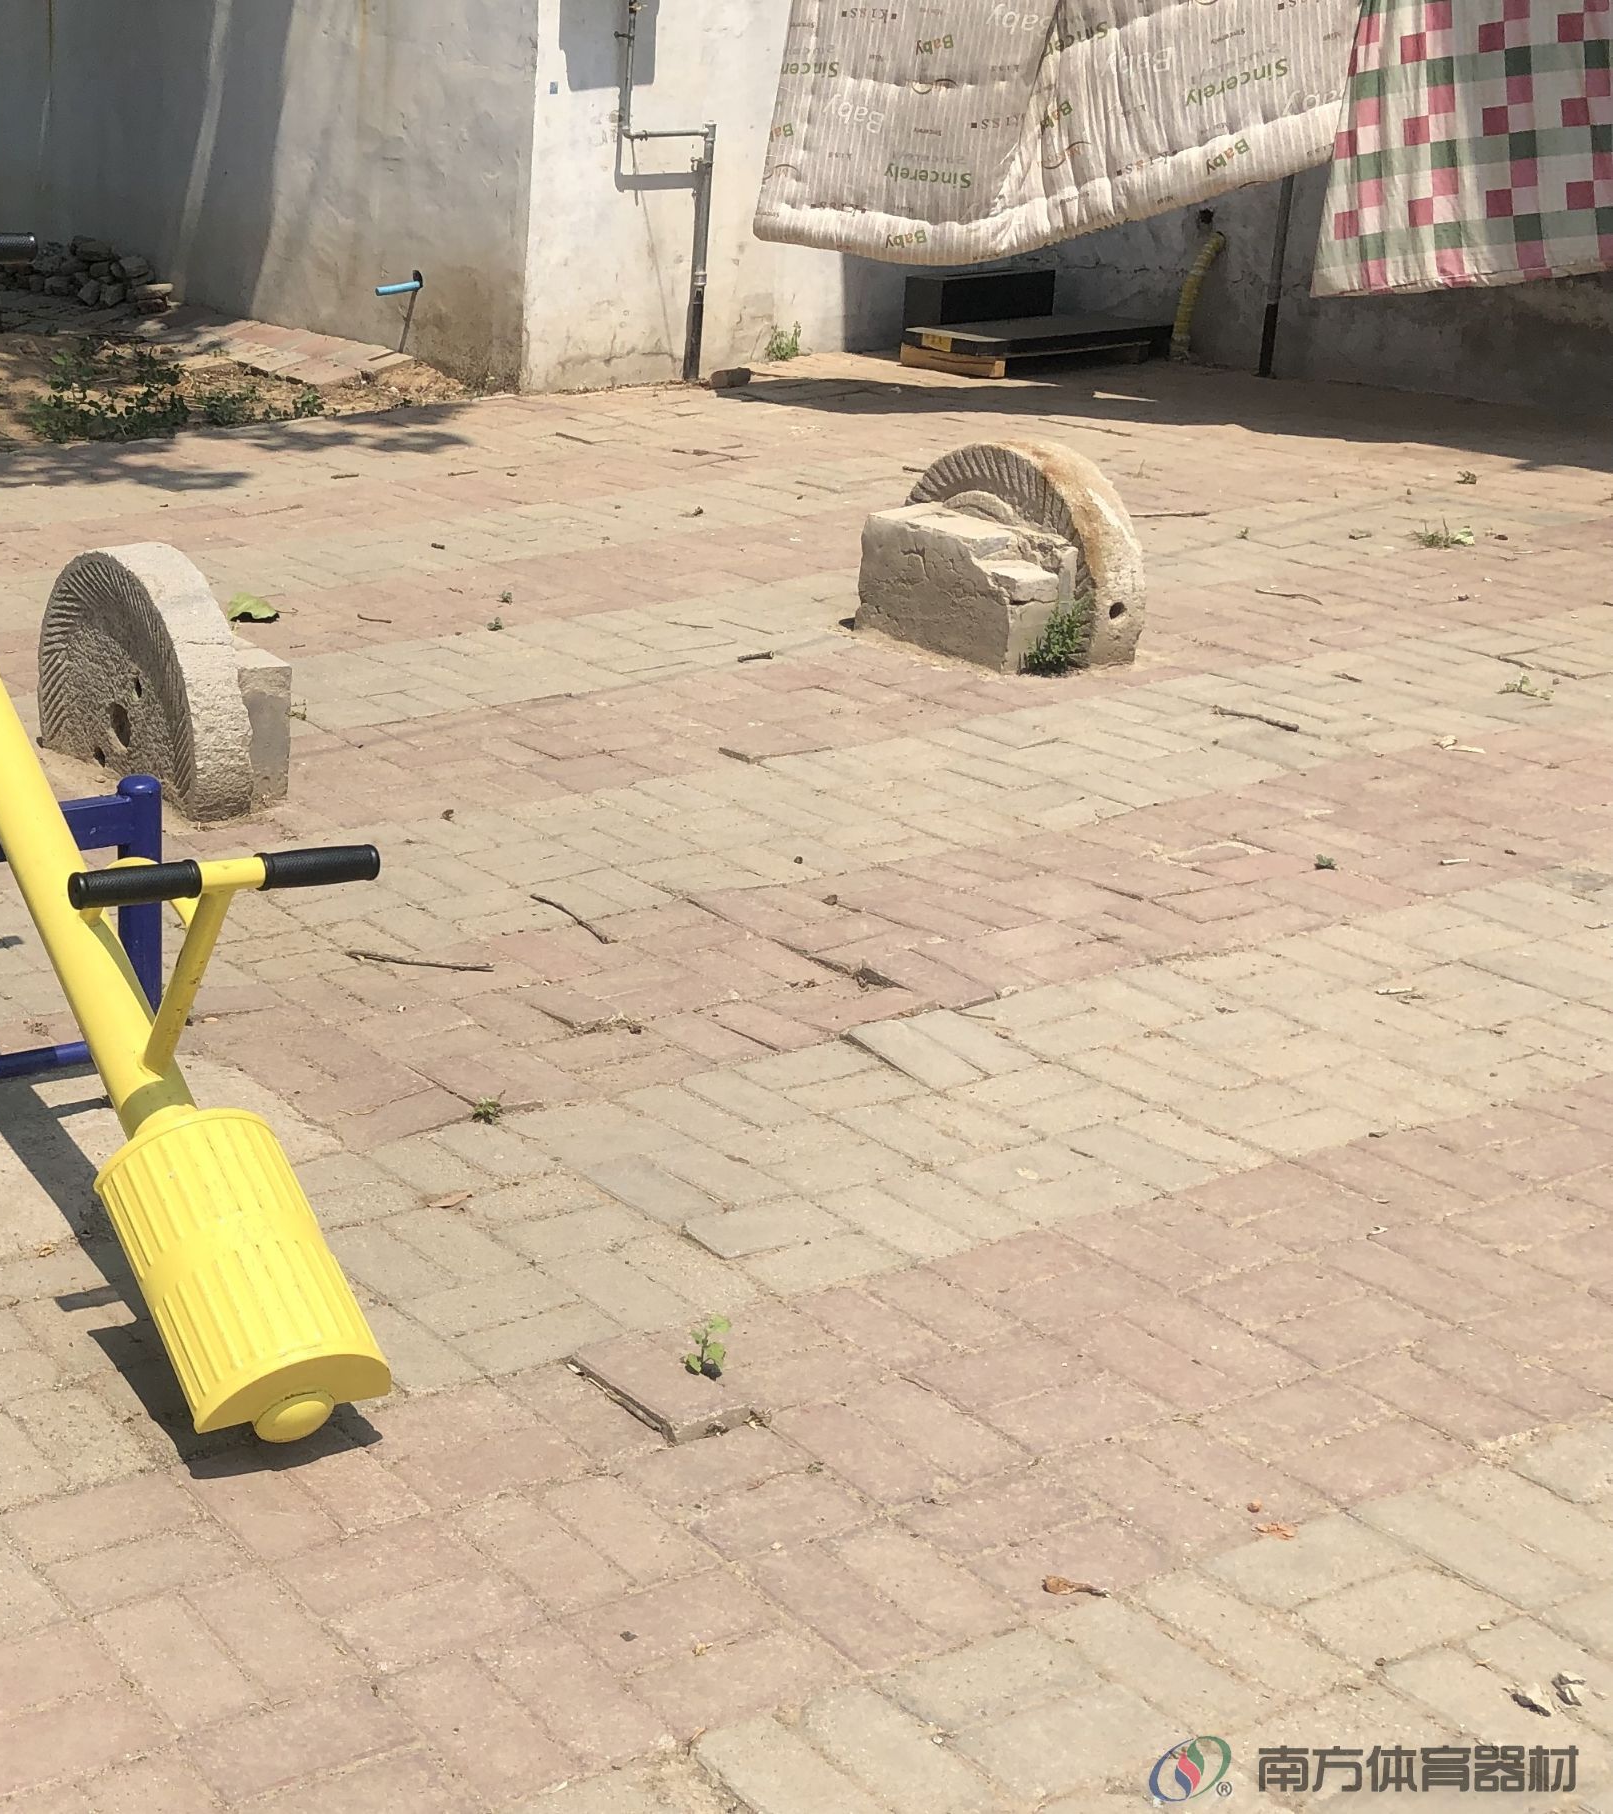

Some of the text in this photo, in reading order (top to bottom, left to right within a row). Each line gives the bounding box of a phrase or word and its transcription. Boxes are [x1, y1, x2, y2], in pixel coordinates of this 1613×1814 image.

[850, 8, 888, 23] kiss
[915, 34, 954, 57] Baby
[1185, 58, 1288, 107] Sincerely
[823, 93, 885, 134] Baby
[1282, 90, 1340, 117] aby
[1124, 151, 1168, 174] kiss
[1206, 137, 1250, 176] Baby
[883, 163, 972, 189] Sincerely
[885, 229, 928, 250] Baby
